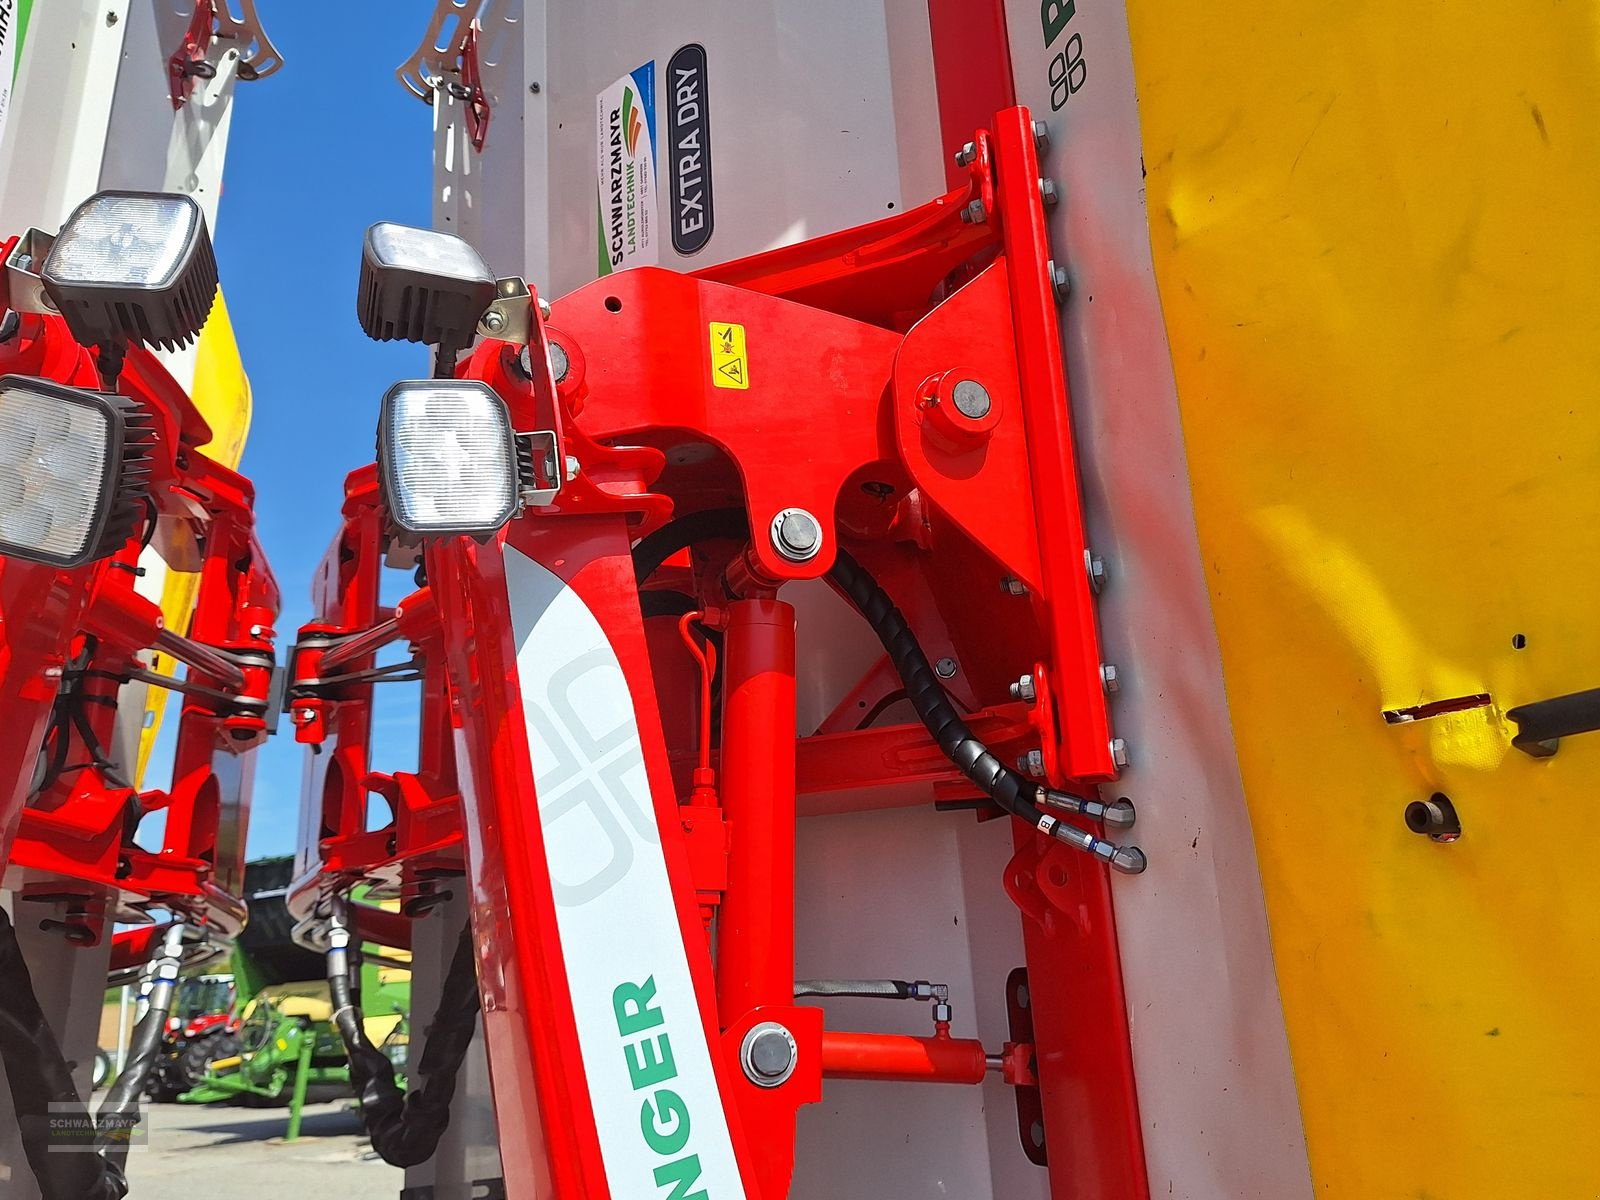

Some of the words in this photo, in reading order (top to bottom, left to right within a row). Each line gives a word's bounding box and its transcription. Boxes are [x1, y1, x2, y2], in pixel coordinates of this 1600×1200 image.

[675, 67, 699, 127] DRY
[609, 106, 624, 267] SCHWARZMAYR
[626, 160, 636, 255] LANDTECHNIK
[678, 127, 704, 236] EXTRA
[1041, 820, 1050, 829] B
